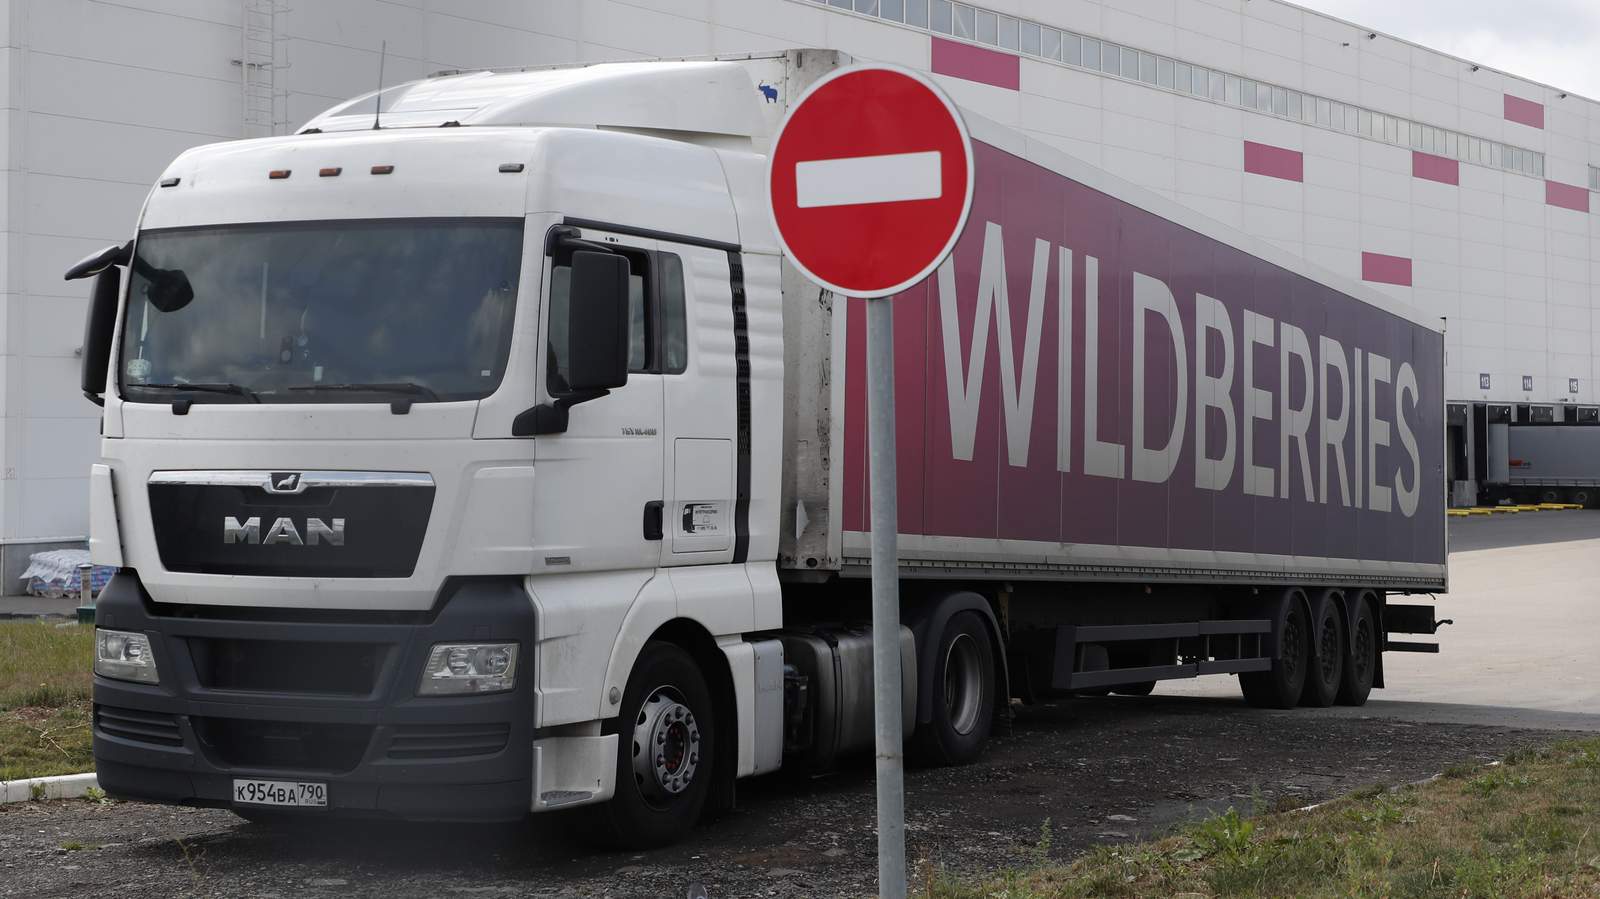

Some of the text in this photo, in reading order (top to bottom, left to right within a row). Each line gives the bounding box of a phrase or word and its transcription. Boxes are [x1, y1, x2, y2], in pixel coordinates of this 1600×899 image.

[937, 220, 1421, 518] WILDBERRIES
[1523, 378, 1532, 390] 114
[1570, 380, 1578, 392] 115
[224, 516, 345, 546] MAN
[299, 784, 323, 799] 790
